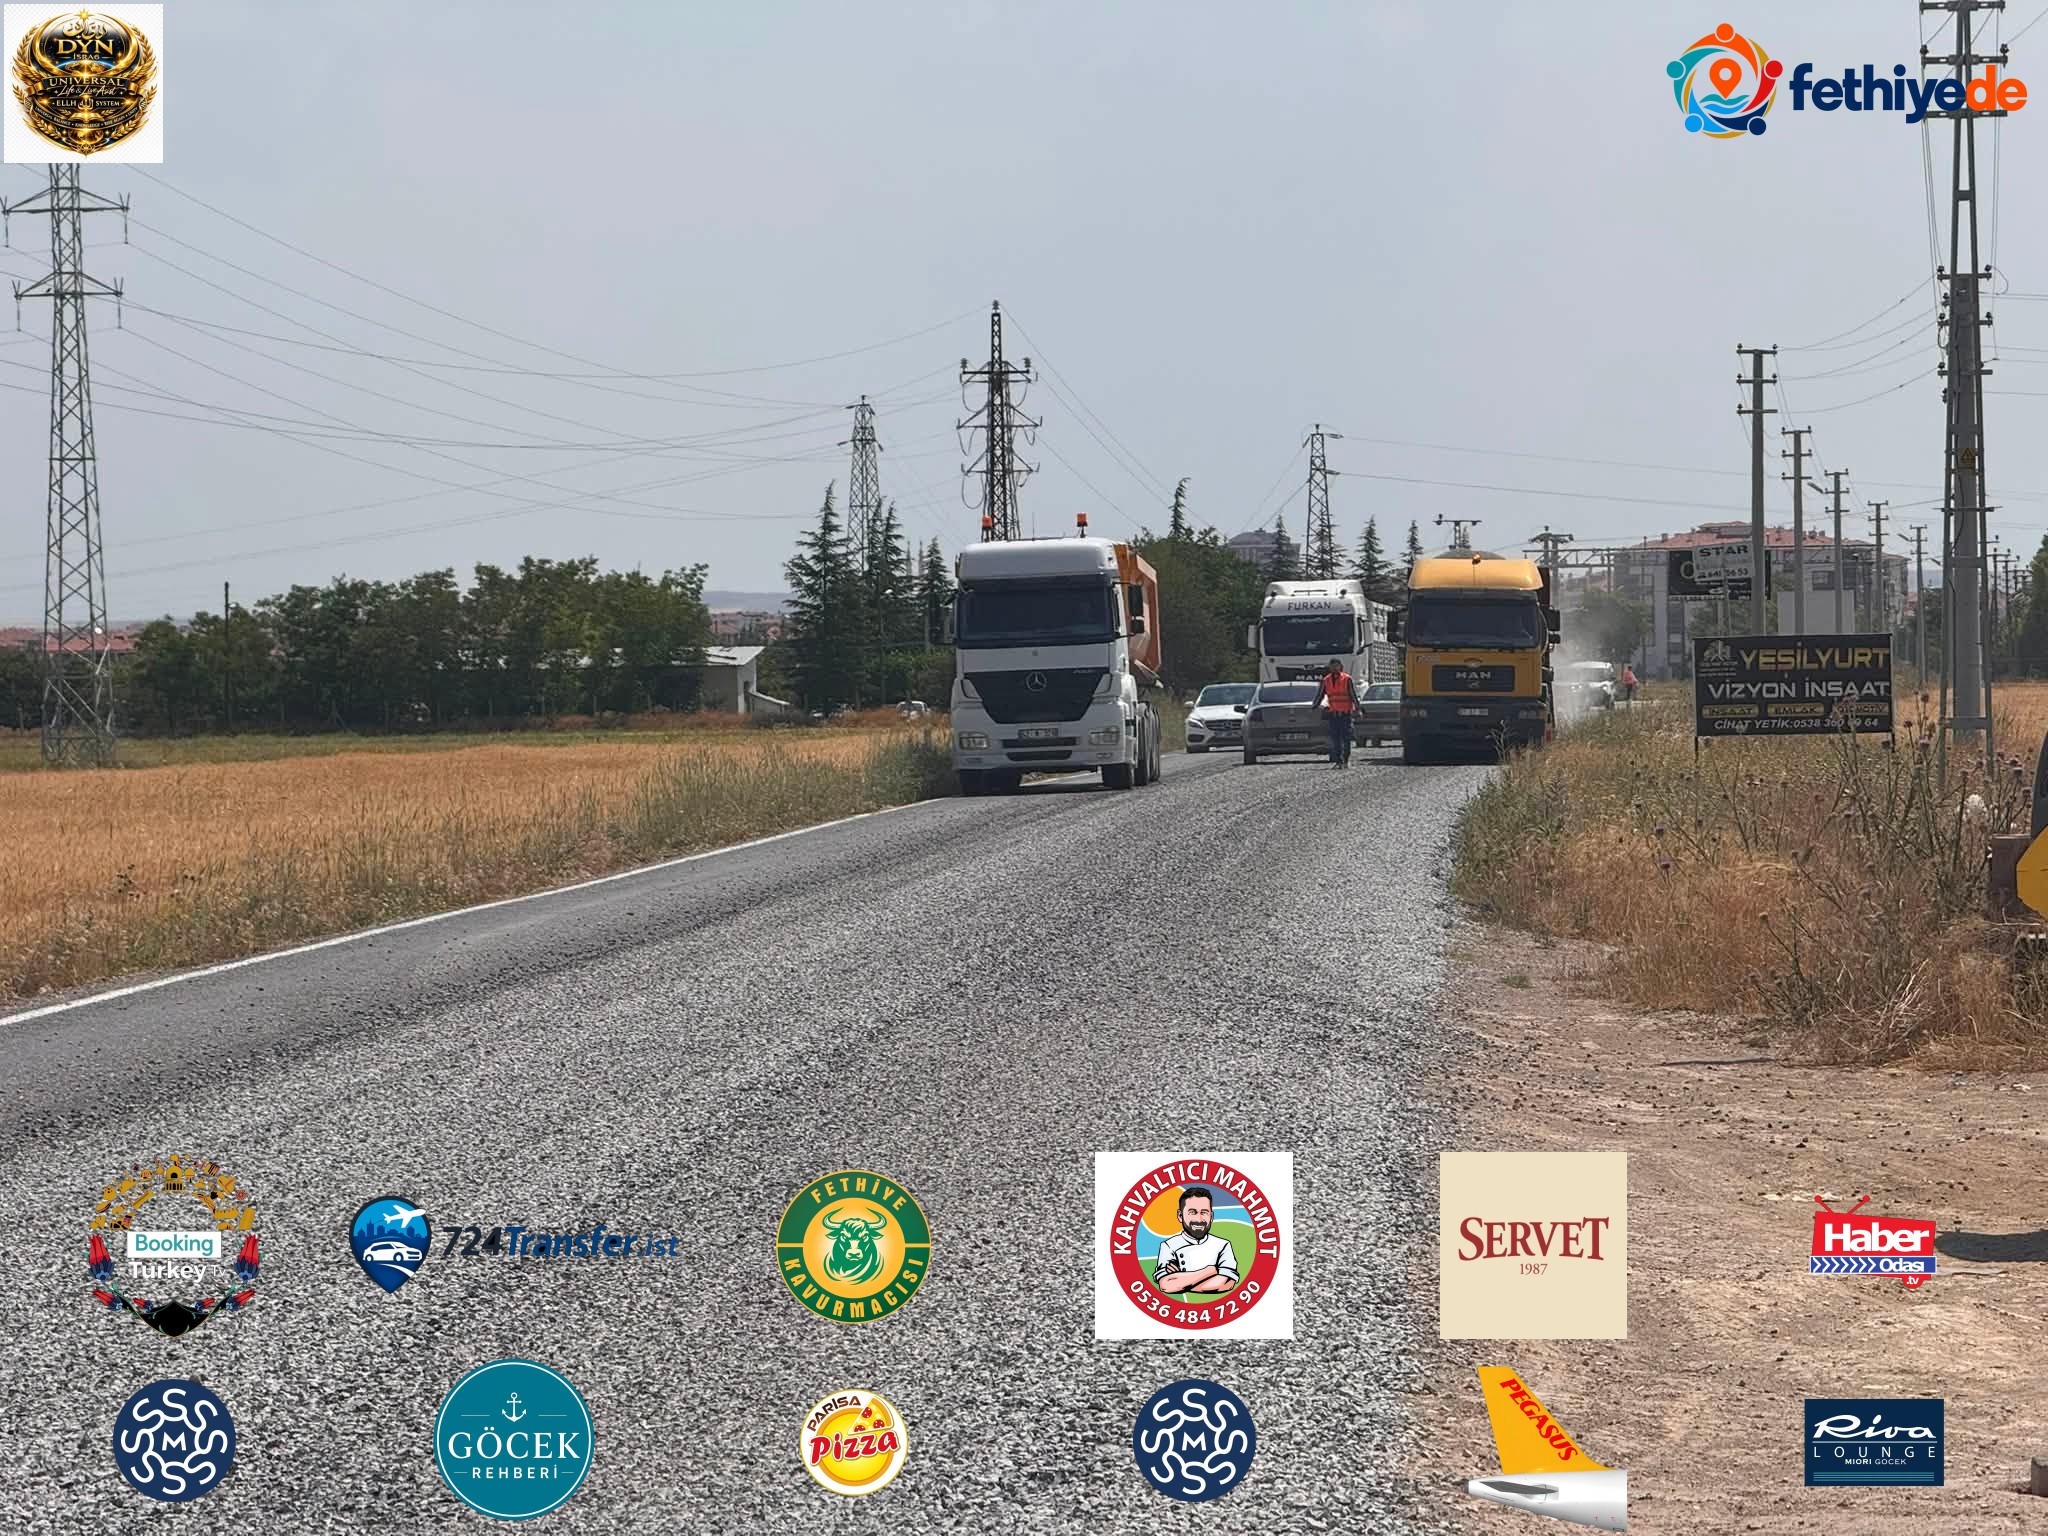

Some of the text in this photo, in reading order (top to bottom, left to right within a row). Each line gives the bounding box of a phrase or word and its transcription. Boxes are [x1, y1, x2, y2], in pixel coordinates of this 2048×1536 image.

[1699, 545, 1749, 557] STAR
[1287, 602, 1332, 611] FURKAN
[1455, 671, 1491, 679] MAN
[1708, 679, 1796, 699] VİZYON
